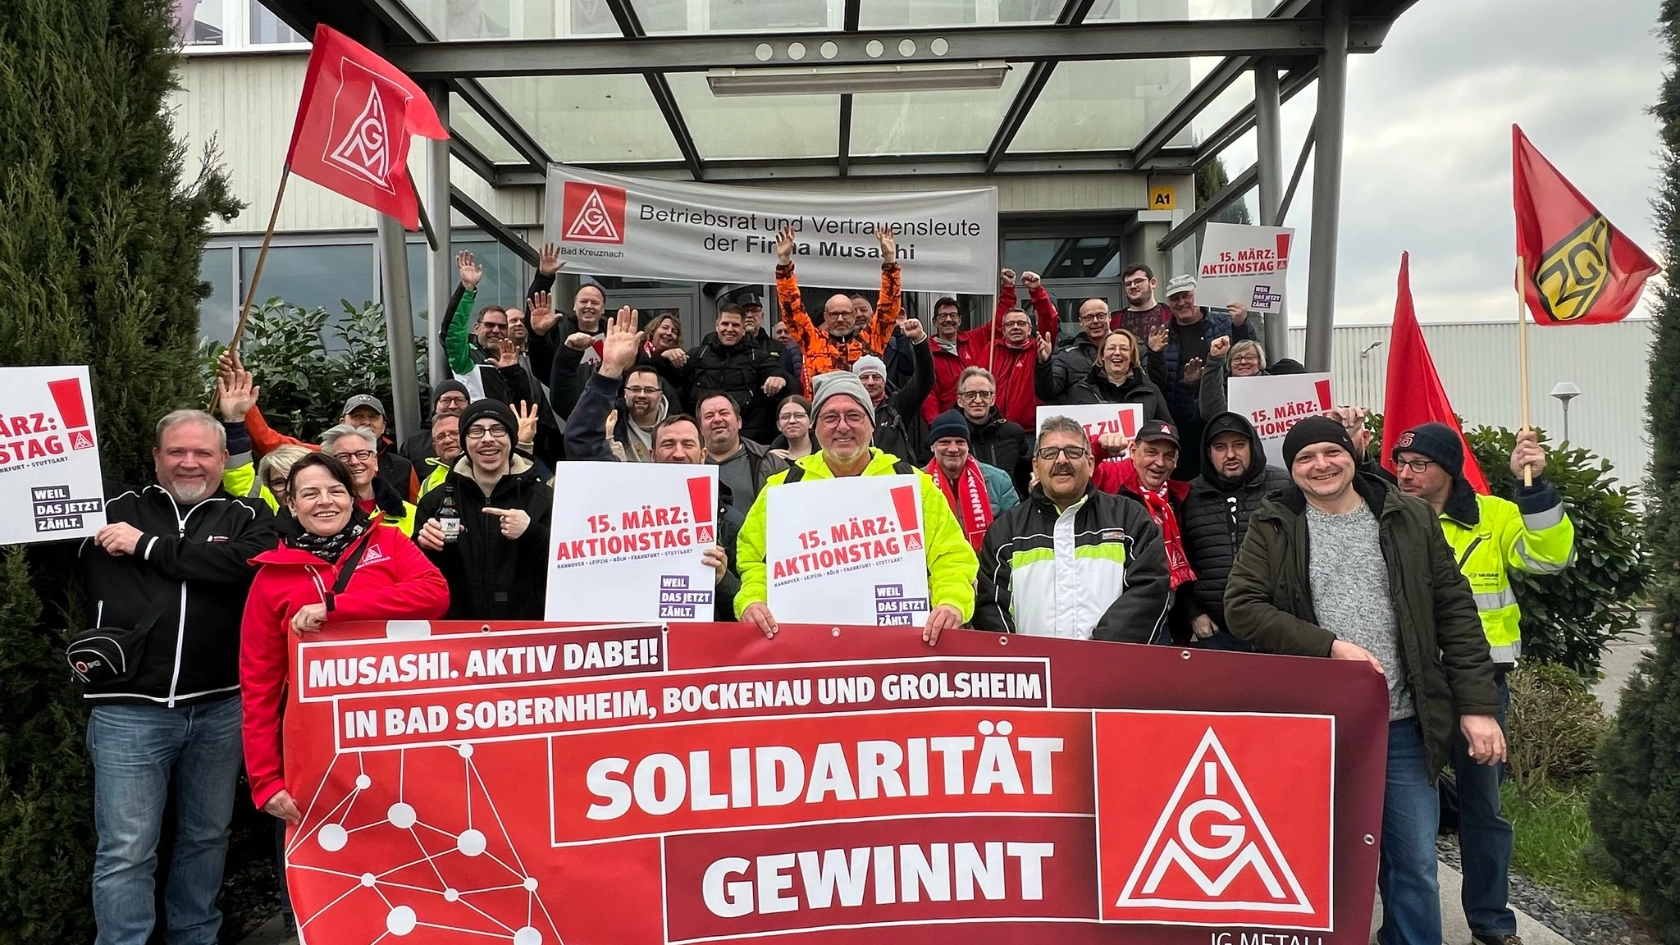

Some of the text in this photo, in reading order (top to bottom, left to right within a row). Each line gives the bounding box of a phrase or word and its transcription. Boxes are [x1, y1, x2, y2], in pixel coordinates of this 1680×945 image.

[1154, 193, 1171, 205] A1
[639, 204, 757, 230] Betriebsrat
[764, 216, 803, 232] und
[560, 247, 624, 258] Bad Kreuznach
[703, 233, 915, 260] der Fira Musahi
[1219, 248, 1275, 262] 15. MÄRZ:
[1201, 261, 1274, 275] AKTIONSTAG
[1251, 400, 1318, 423] 15. MÄRZ:
[31, 456, 68, 468] STUTTGART
[34, 488, 66, 500] WEIL
[36, 501, 99, 516] DAS JETZT
[38, 518, 81, 531] ZÄHLT.
[587, 505, 689, 533] 15. MÄRZ:
[797, 530, 827, 550] 15.
[831, 516, 896, 544] MÄRZ:
[556, 528, 691, 561] AKTIONSTAG
[589, 558, 609, 566] LEIPZIG
[664, 549, 693, 557] STUTTGART
[773, 537, 900, 580] AKTIONSTAG
[774, 556, 903, 588] HANNOVER LEIPZIG KÖLN FRANKFURT STUTTGART
[662, 577, 687, 588] WEIL
[661, 592, 710, 604] DAS JETZT
[876, 587, 901, 598] WEIL
[661, 605, 694, 618] ZÄHLT.
[878, 600, 925, 613] DAS JETZT
[878, 614, 911, 627] ZÄHLT.
[308, 637, 659, 689] MUSASHI. AKTIV DABEI!
[344, 671, 1042, 739] IN BAD SOBERNHEIM, BOCKENAU UND GROLSHEIM
[585, 719, 1065, 821] SOLIDARITÄT
[702, 840, 1055, 919] GEWINNT
